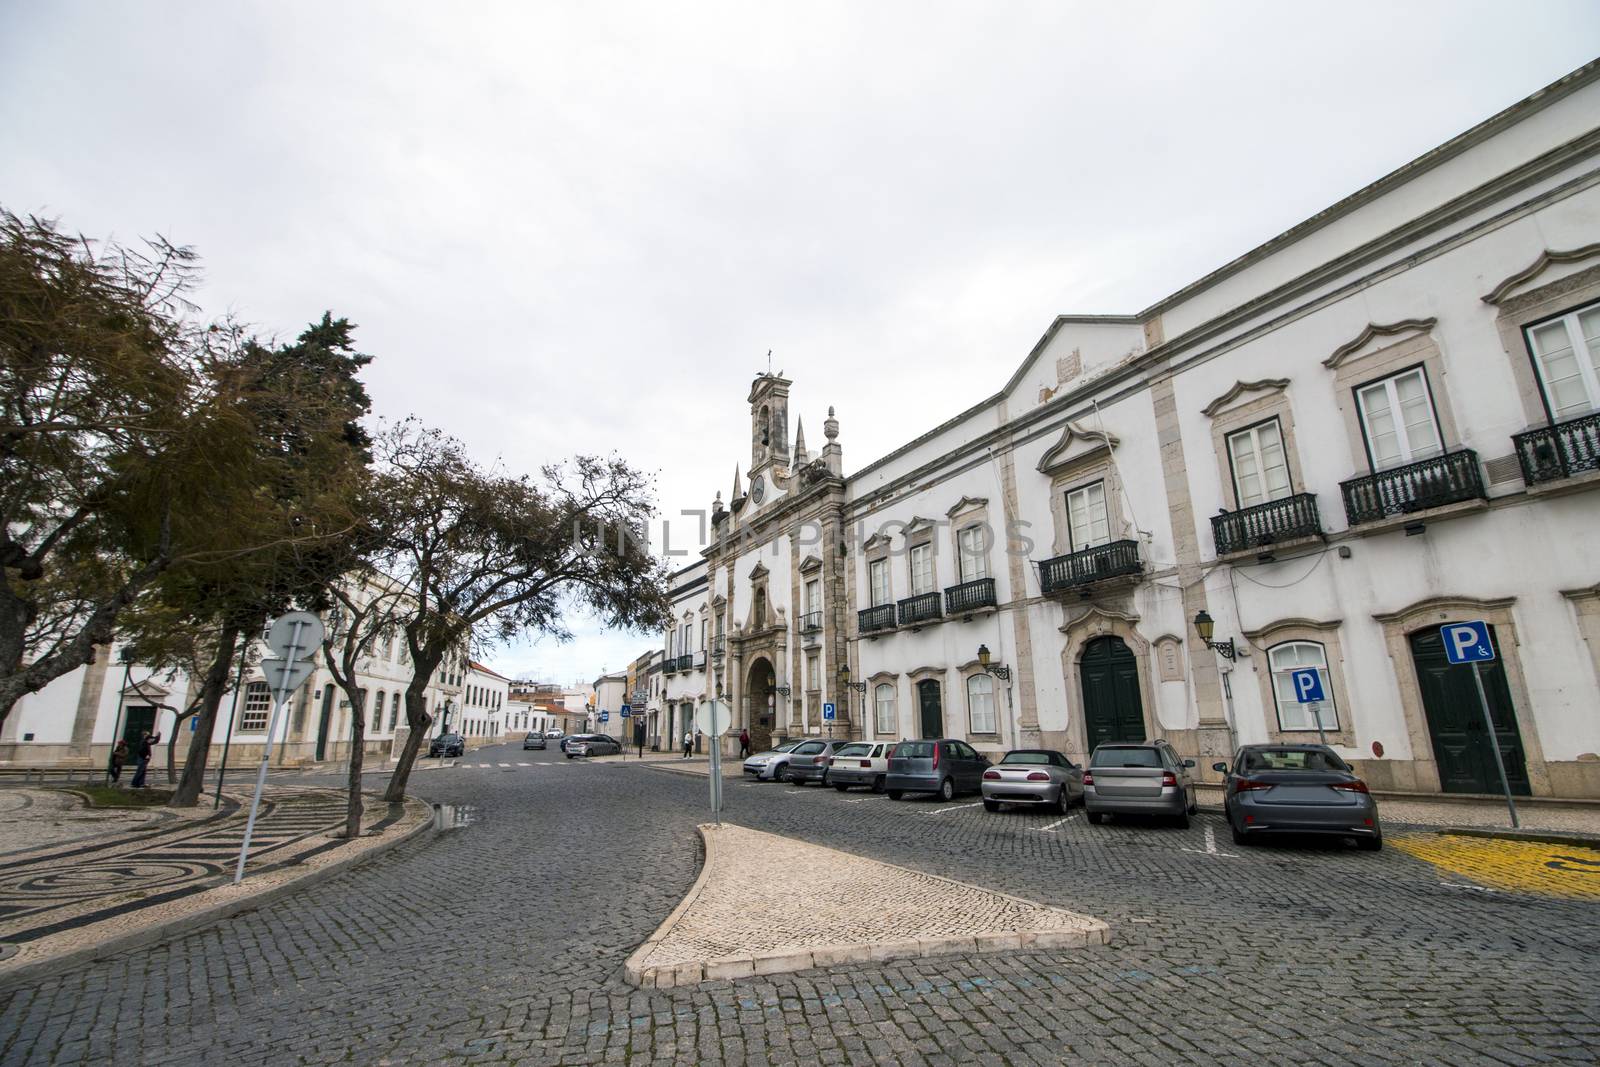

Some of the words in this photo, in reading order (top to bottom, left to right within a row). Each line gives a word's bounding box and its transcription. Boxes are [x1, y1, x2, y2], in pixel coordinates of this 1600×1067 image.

[1450, 626, 1479, 660] P
[1297, 672, 1315, 700] P
[825, 704, 833, 718] P
